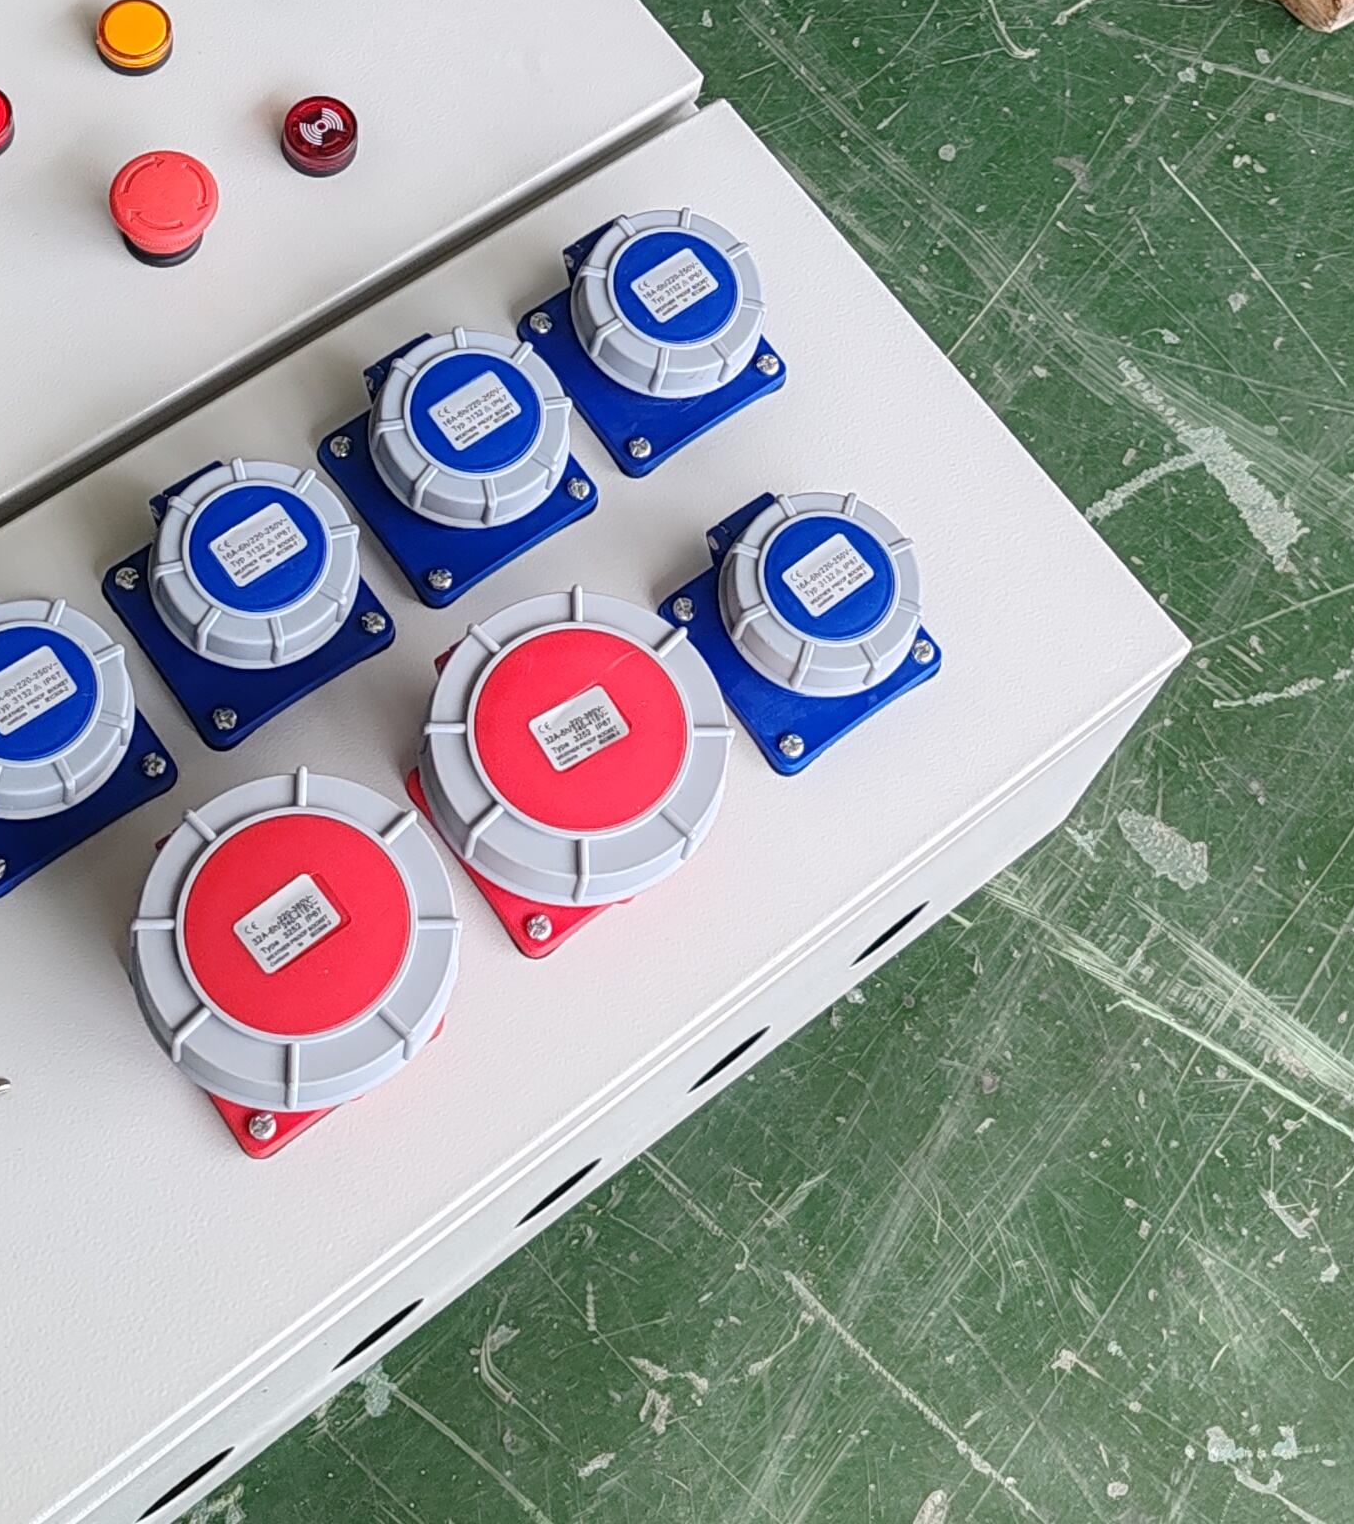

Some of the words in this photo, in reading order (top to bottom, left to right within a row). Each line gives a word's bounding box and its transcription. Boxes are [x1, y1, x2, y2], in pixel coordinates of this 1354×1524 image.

[11, 688, 32, 704] 3132
[551, 742, 570, 753] Type
[261, 940, 280, 954] Type
